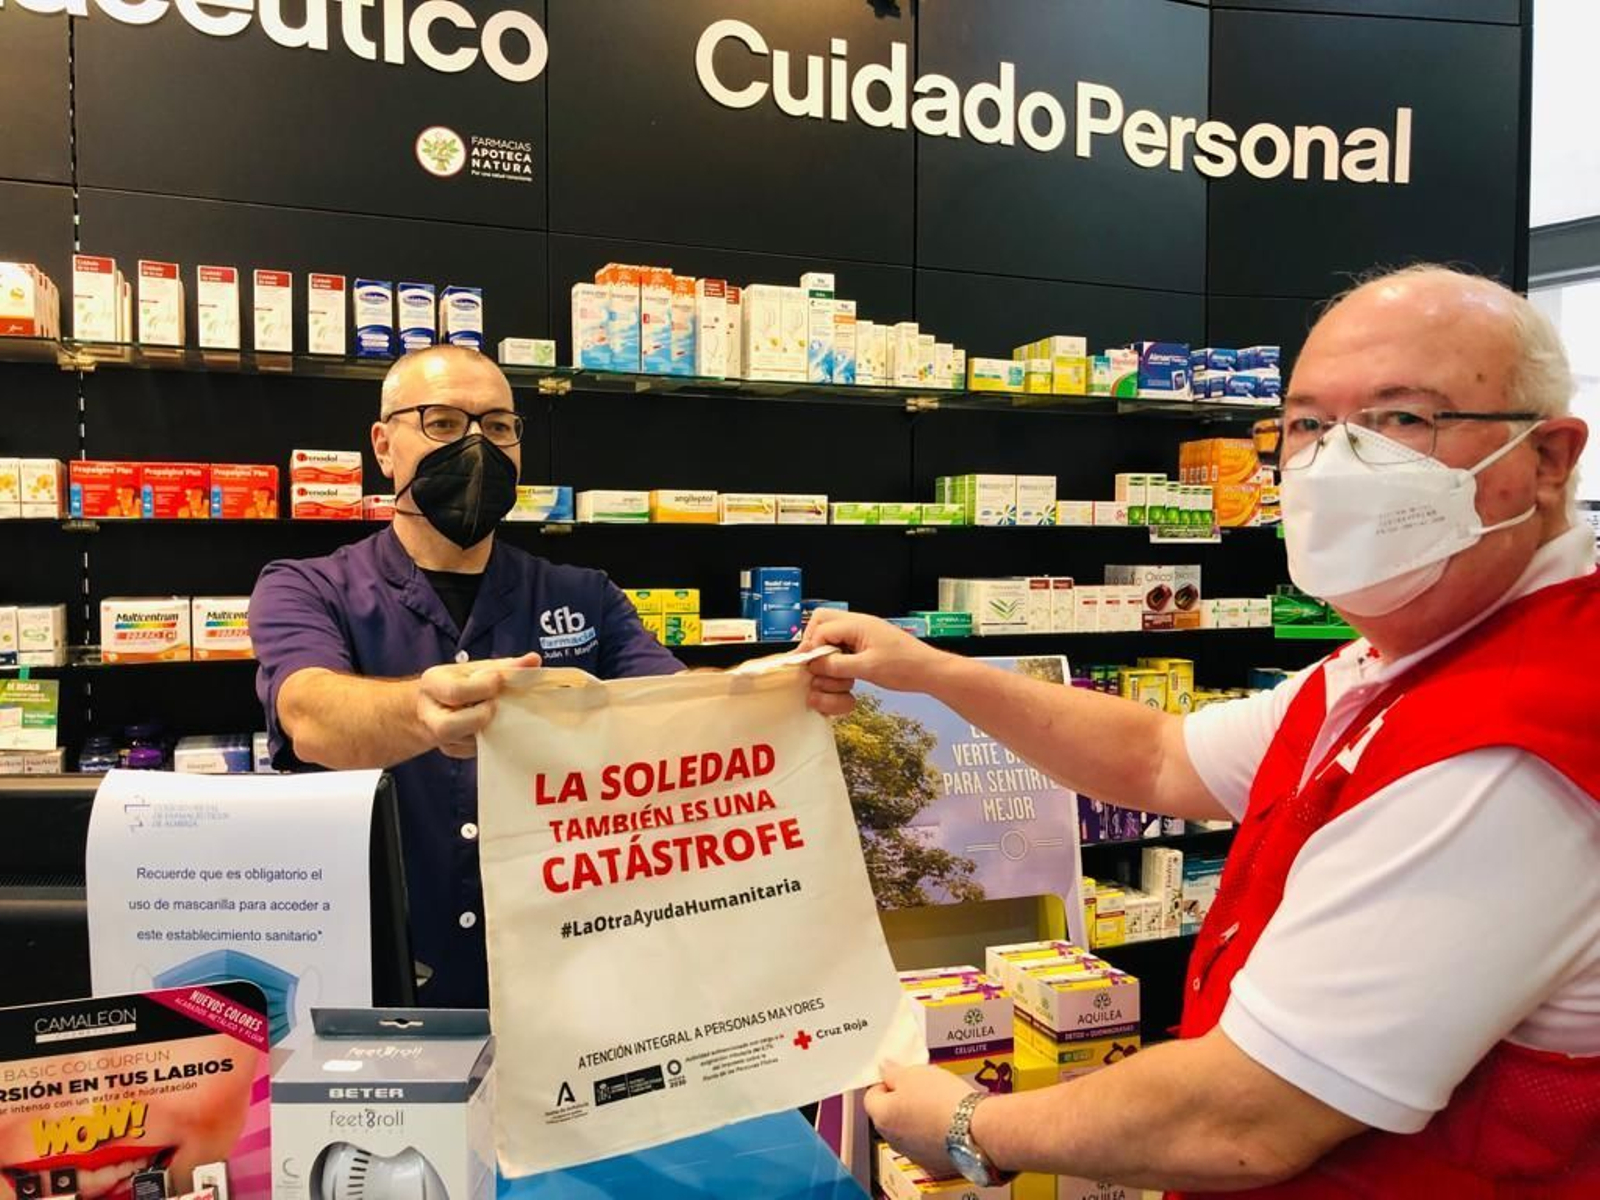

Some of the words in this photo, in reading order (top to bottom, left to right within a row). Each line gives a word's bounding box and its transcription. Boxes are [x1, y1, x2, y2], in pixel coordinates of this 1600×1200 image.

[13, 0, 549, 82] utico
[695, 19, 1067, 153] Cuidado
[1076, 81, 1413, 185] Personal
[471, 135, 532, 152] FARMACIAS
[471, 147, 532, 163] APOTECA
[471, 159, 532, 175] NATURA
[116, 612, 179, 622] Multicentrum
[206, 611, 249, 620] Multicent
[952, 743, 1001, 767] VERTE
[534, 772, 588, 806] LA
[600, 743, 775, 801] SOLEDAD
[942, 771, 983, 796] PARA
[550, 804, 674, 843] TAMBIÉN
[682, 800, 709, 823] ES
[714, 789, 777, 818] UNA
[983, 796, 1036, 822] MEJOR
[542, 818, 805, 893] CATÁSTROFE
[136, 867, 196, 880] Recuerde
[199, 869, 223, 882] que
[226, 870, 241, 880] es
[245, 867, 308, 882] obligatorio
[311, 868, 322, 880] el
[128, 900, 150, 911] uso
[154, 899, 170, 911] de
[173, 899, 236, 911] mascarilla
[239, 901, 267, 912] para
[270, 899, 319, 912] acceder
[322, 902, 331, 911] a
[560, 878, 802, 939] #LaOtraAyudaHumanitaria
[136, 930, 163, 941] este
[166, 929, 262, 942] establecimiento
[35, 1008, 136, 1033] CAMALEON
[189, 990, 225, 1014] NUEVOS
[223, 1006, 263, 1032] COLORES
[1077, 1010, 1123, 1026] AQUILEA
[577, 1040, 633, 1070] ATENCIÓN
[633, 1030, 693, 1056] INTEGRAL
[693, 1027, 704, 1041] A
[704, 1011, 767, 1037] PERSONAS
[768, 997, 826, 1022] MAYORES
[816, 1026, 842, 1040] Cruz
[843, 1018, 869, 1034] Roja
[947, 1025, 996, 1041] AQUILEA
[955, 1044, 988, 1055] CELULITE
[4, 1065, 57, 1082] BASIC
[62, 1050, 170, 1074] COLOURFUN
[69, 1077, 99, 1094] EN
[104, 1071, 149, 1088] TUS
[154, 1058, 234, 1082] LABIOS
[10, 1102, 51, 1113] intenso
[54, 1099, 73, 1108] con
[76, 1098, 89, 1106] un
[92, 1093, 120, 1104] extra
[123, 1090, 135, 1099] de
[139, 1081, 197, 1096] hidratación
[329, 1087, 404, 1099] BETER
[31, 1099, 149, 1158] WOW!
